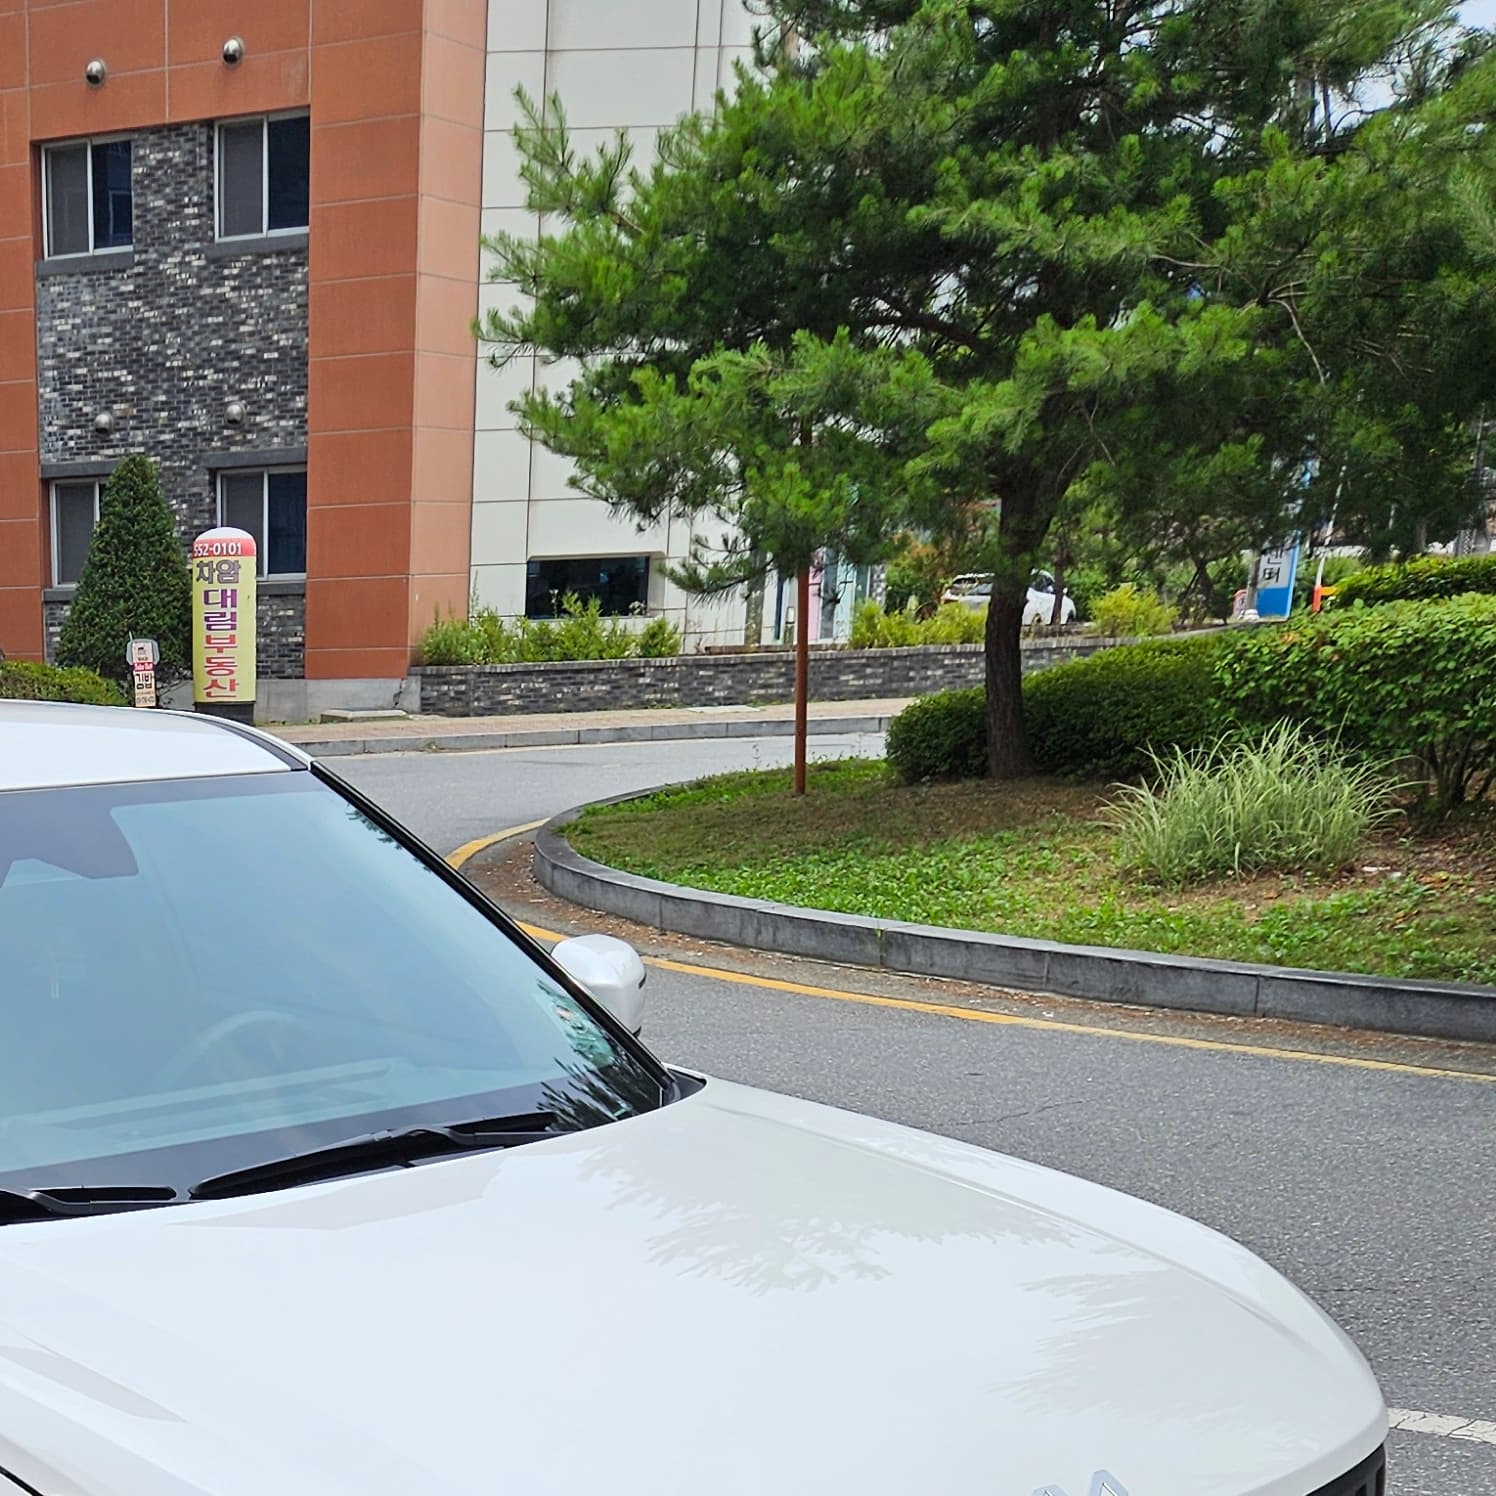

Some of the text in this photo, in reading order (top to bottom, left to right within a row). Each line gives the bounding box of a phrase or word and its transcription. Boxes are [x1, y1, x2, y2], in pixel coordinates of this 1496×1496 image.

[194, 541, 242, 557] 552-0101
[196, 559, 242, 585] 차암
[203, 588, 240, 698] 대림부동산
